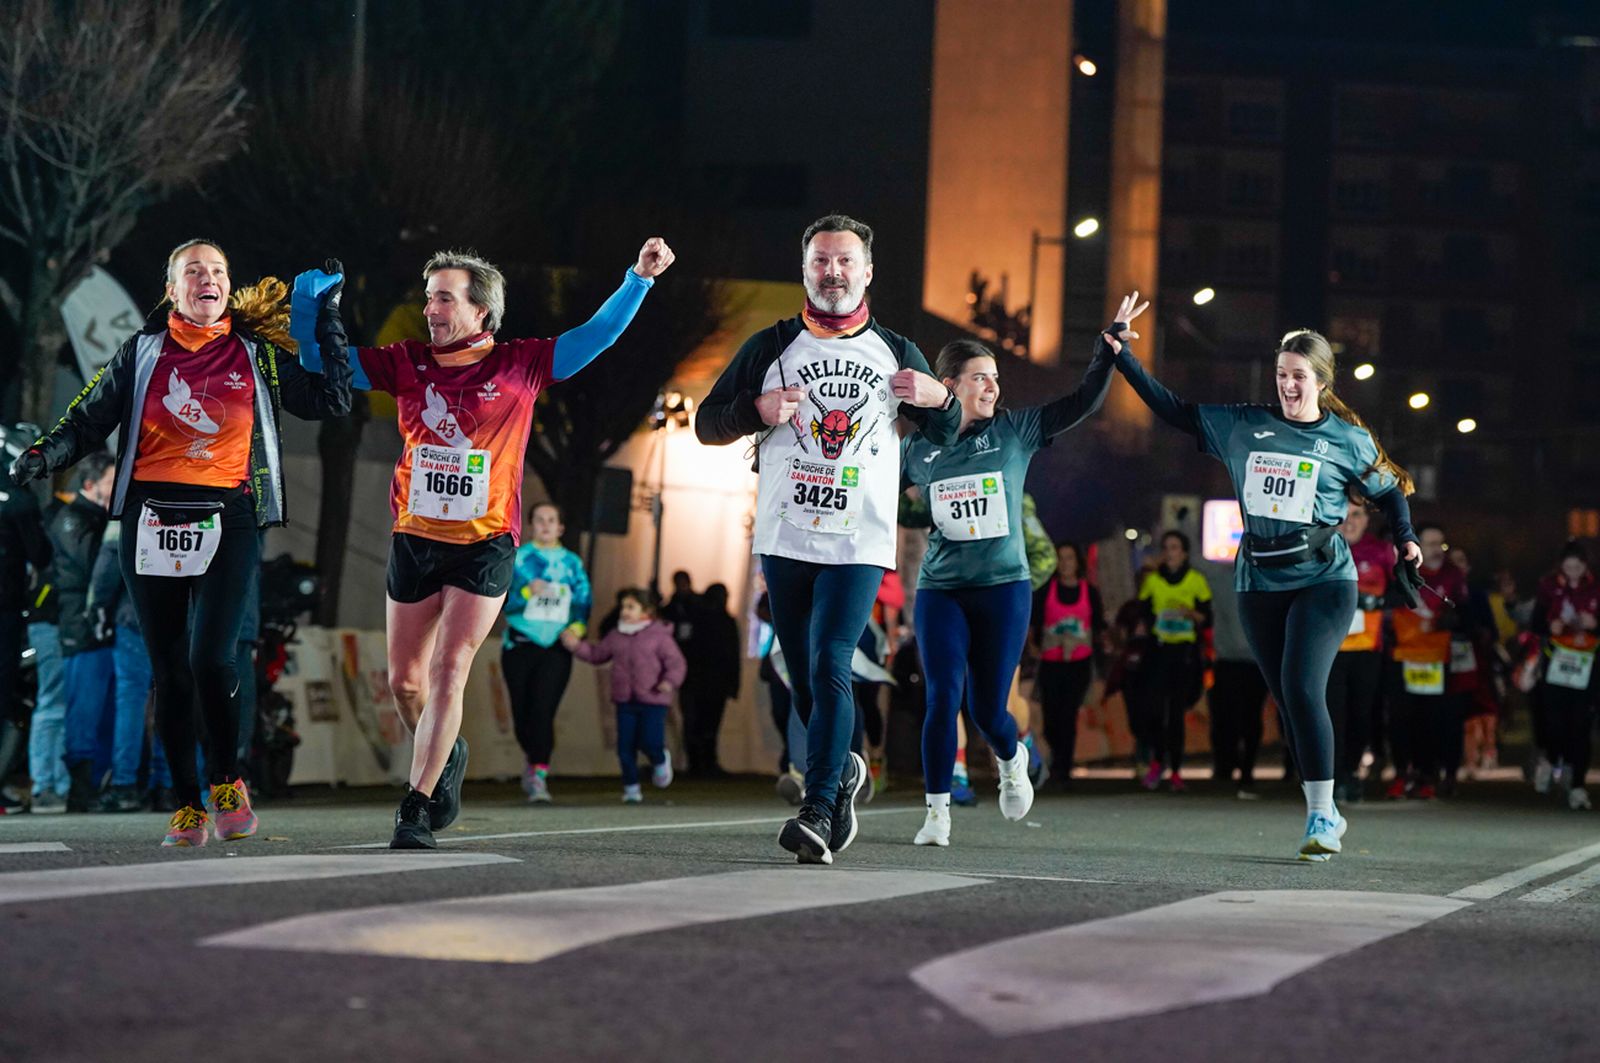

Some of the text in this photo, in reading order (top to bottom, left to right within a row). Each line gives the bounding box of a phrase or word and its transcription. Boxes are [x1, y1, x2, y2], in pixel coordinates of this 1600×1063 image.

[819, 382, 860, 398] CLUB
[178, 403, 201, 423] 43
[436, 419, 457, 439] 43
[420, 460, 433, 469] SAN
[434, 461, 461, 473] ANTÓN
[429, 453, 450, 463] NOCHE
[452, 455, 461, 464] DE
[791, 471, 805, 481] SAN
[801, 464, 824, 474] NOCHE
[825, 467, 835, 475] DE
[1254, 465, 1267, 474] SAN
[425, 471, 473, 497] 1666
[1263, 476, 1296, 497] 901
[793, 482, 847, 511] 3425
[938, 493, 953, 501] SAN
[950, 497, 988, 520] 3117
[156, 528, 204, 552] 1667
